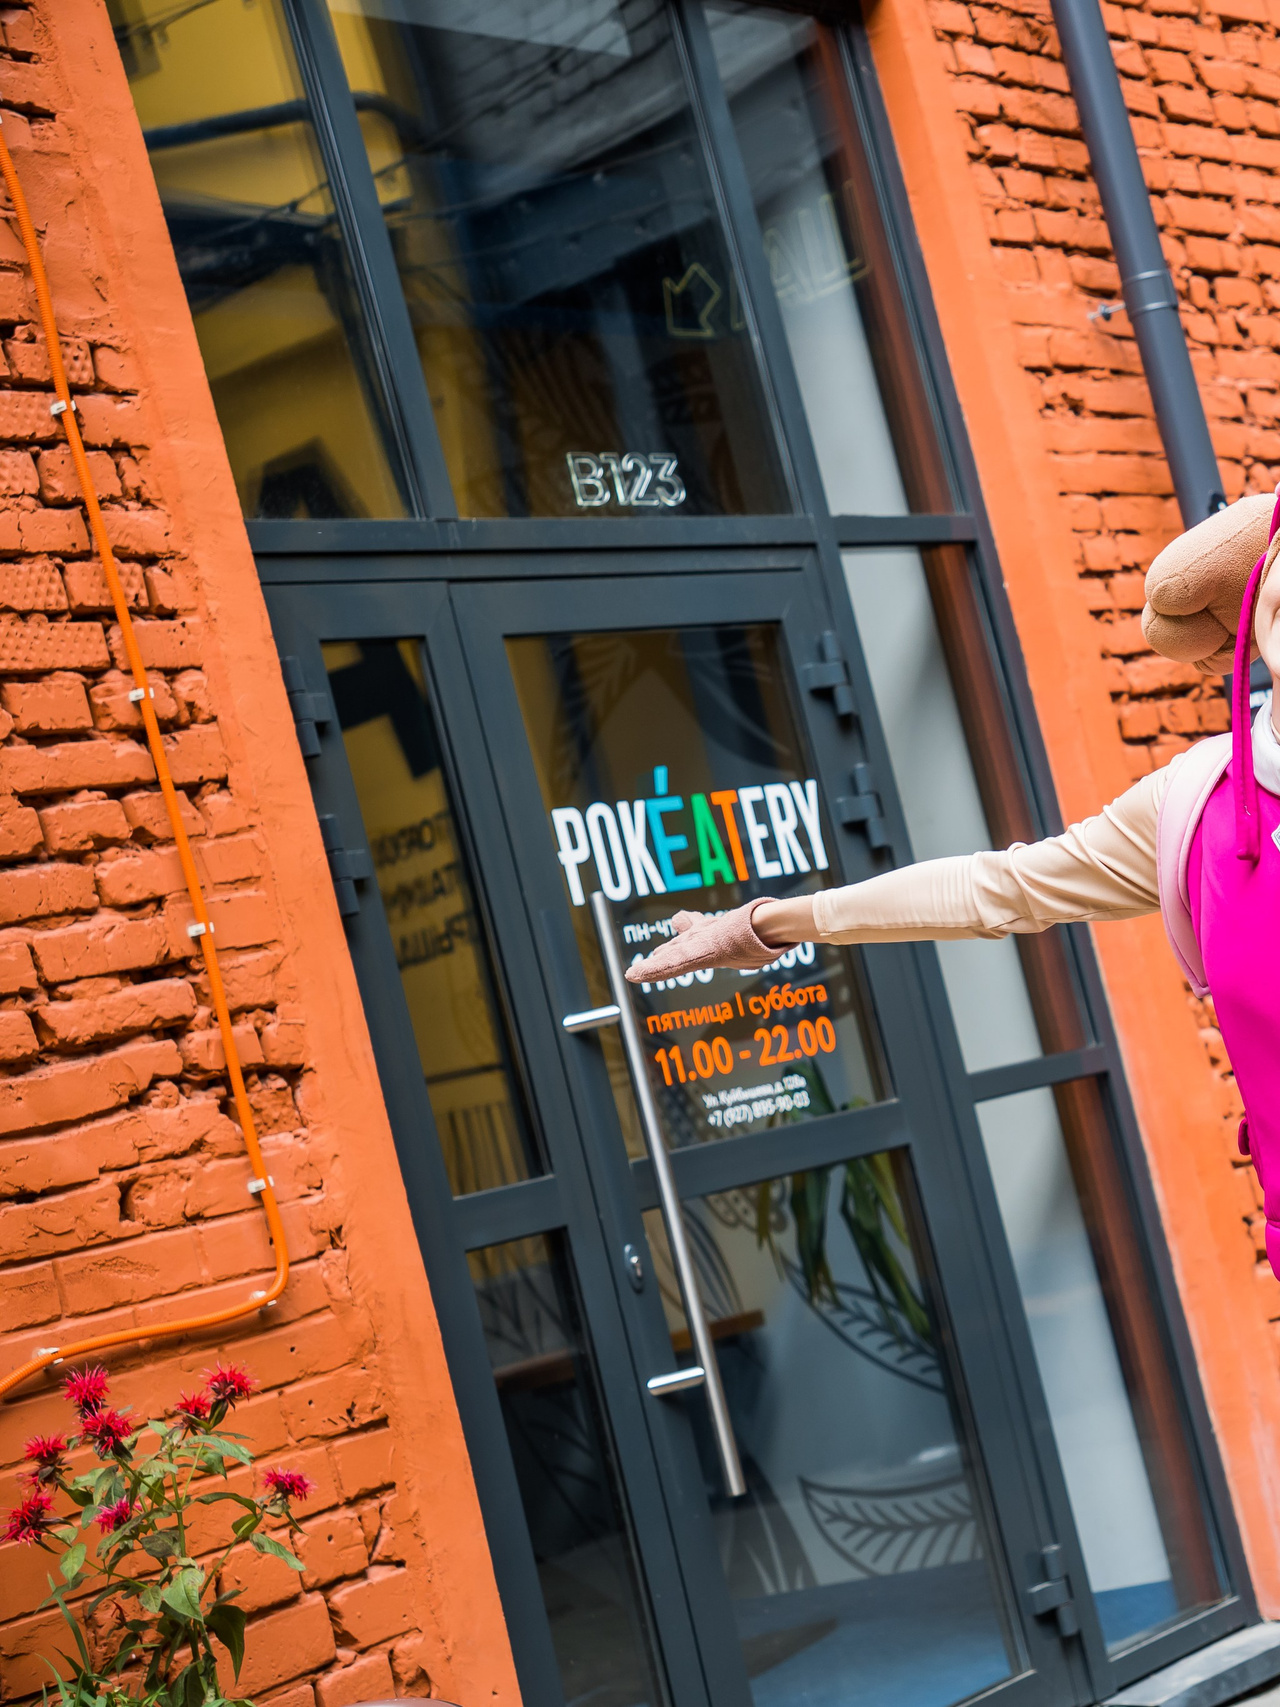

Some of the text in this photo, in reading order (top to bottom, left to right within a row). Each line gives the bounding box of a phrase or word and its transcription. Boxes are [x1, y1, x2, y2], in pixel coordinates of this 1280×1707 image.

[566, 452, 686, 506] B123
[551, 765, 829, 906] POKÉATERY
[646, 1001, 733, 1034] пятница
[749, 983, 828, 1019] суббота
[654, 1036, 733, 1086] 11.00
[754, 1016, 836, 1067] 22.00
